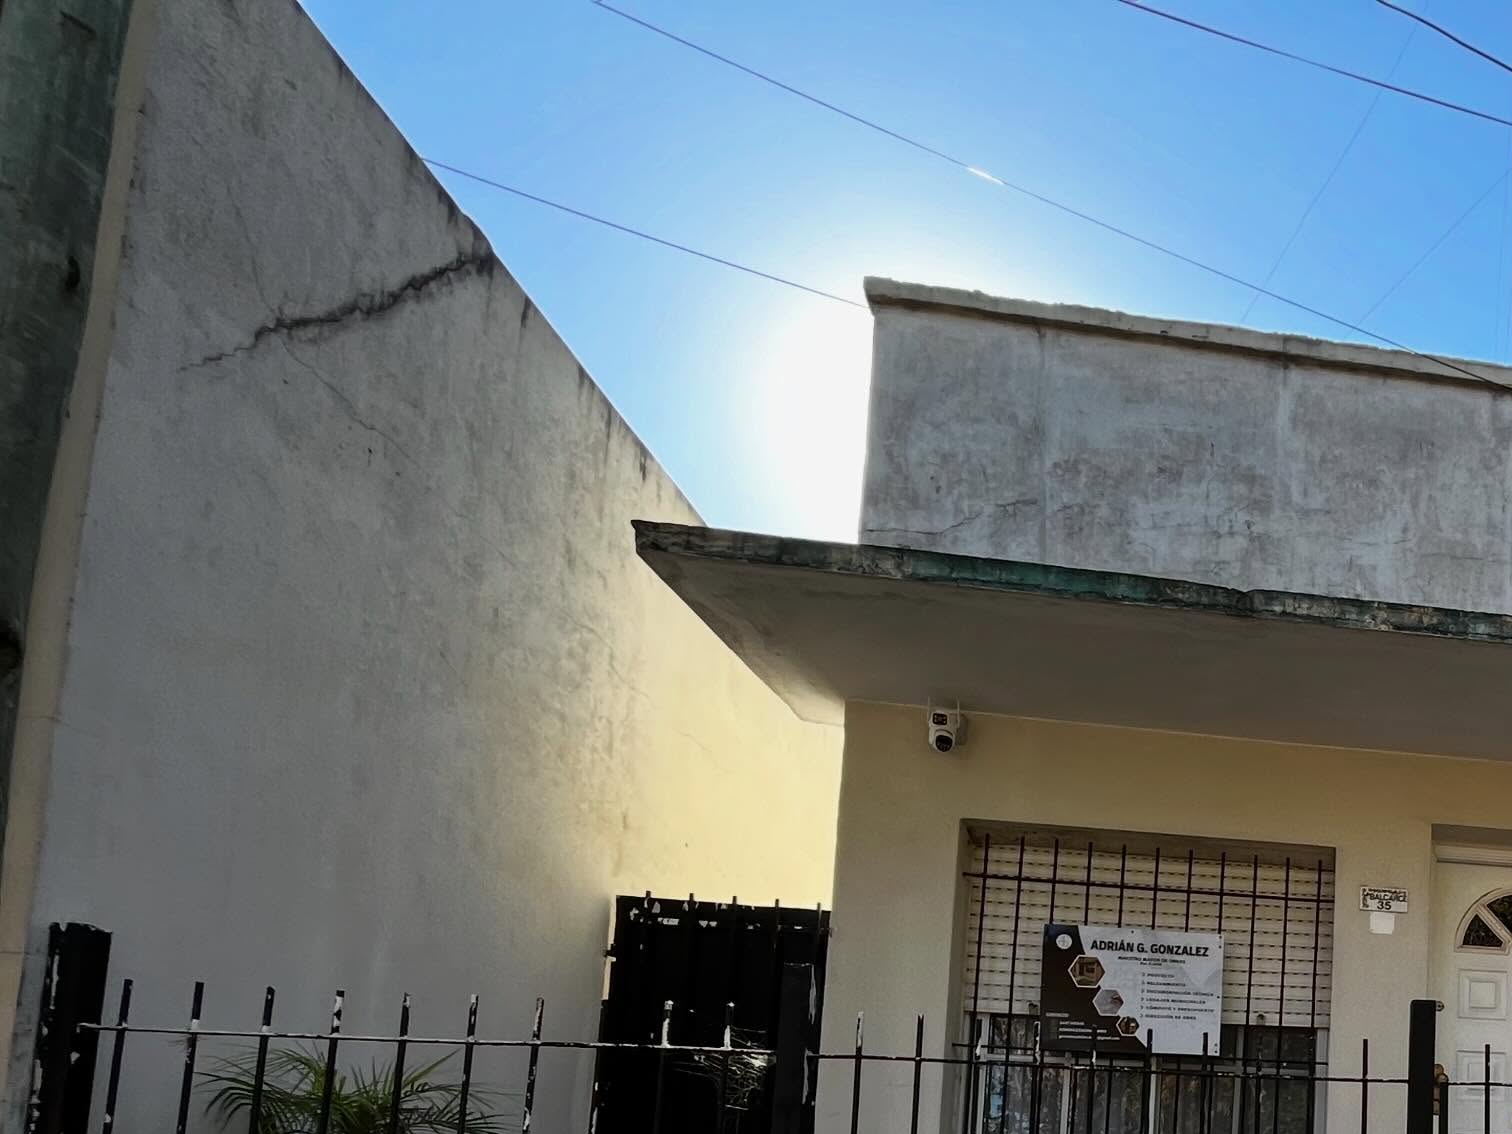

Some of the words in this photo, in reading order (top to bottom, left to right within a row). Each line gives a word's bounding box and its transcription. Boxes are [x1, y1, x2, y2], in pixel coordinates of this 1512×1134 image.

[1377, 901, 1391, 910] 35
[1091, 940, 1134, 952] ADRIÁN
[1137, 943, 1148, 953] G.
[1151, 944, 1209, 957] GONZALEZ
